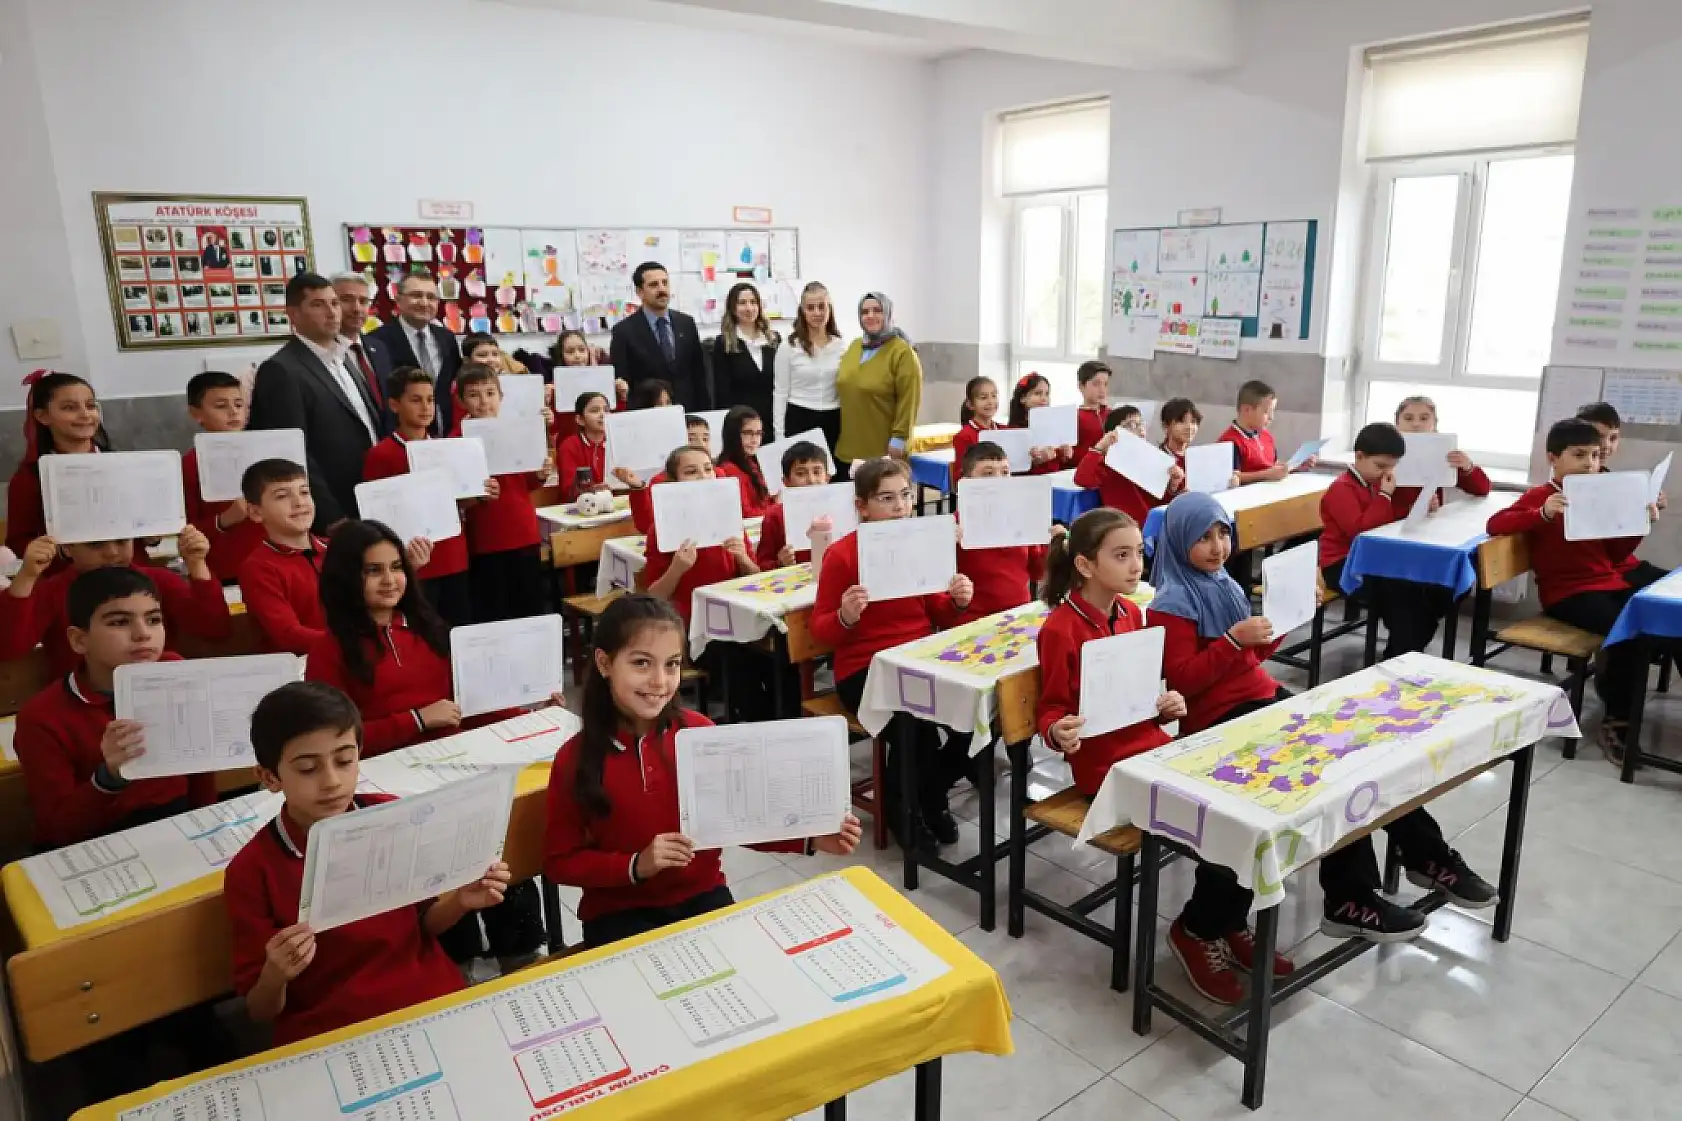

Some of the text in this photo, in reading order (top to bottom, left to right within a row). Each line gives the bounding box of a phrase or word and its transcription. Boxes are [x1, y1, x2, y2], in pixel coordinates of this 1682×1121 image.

[156, 204, 258, 219] ATATÜRK KÖŞESİ
[609, 1064, 670, 1091] ÇARPIM
